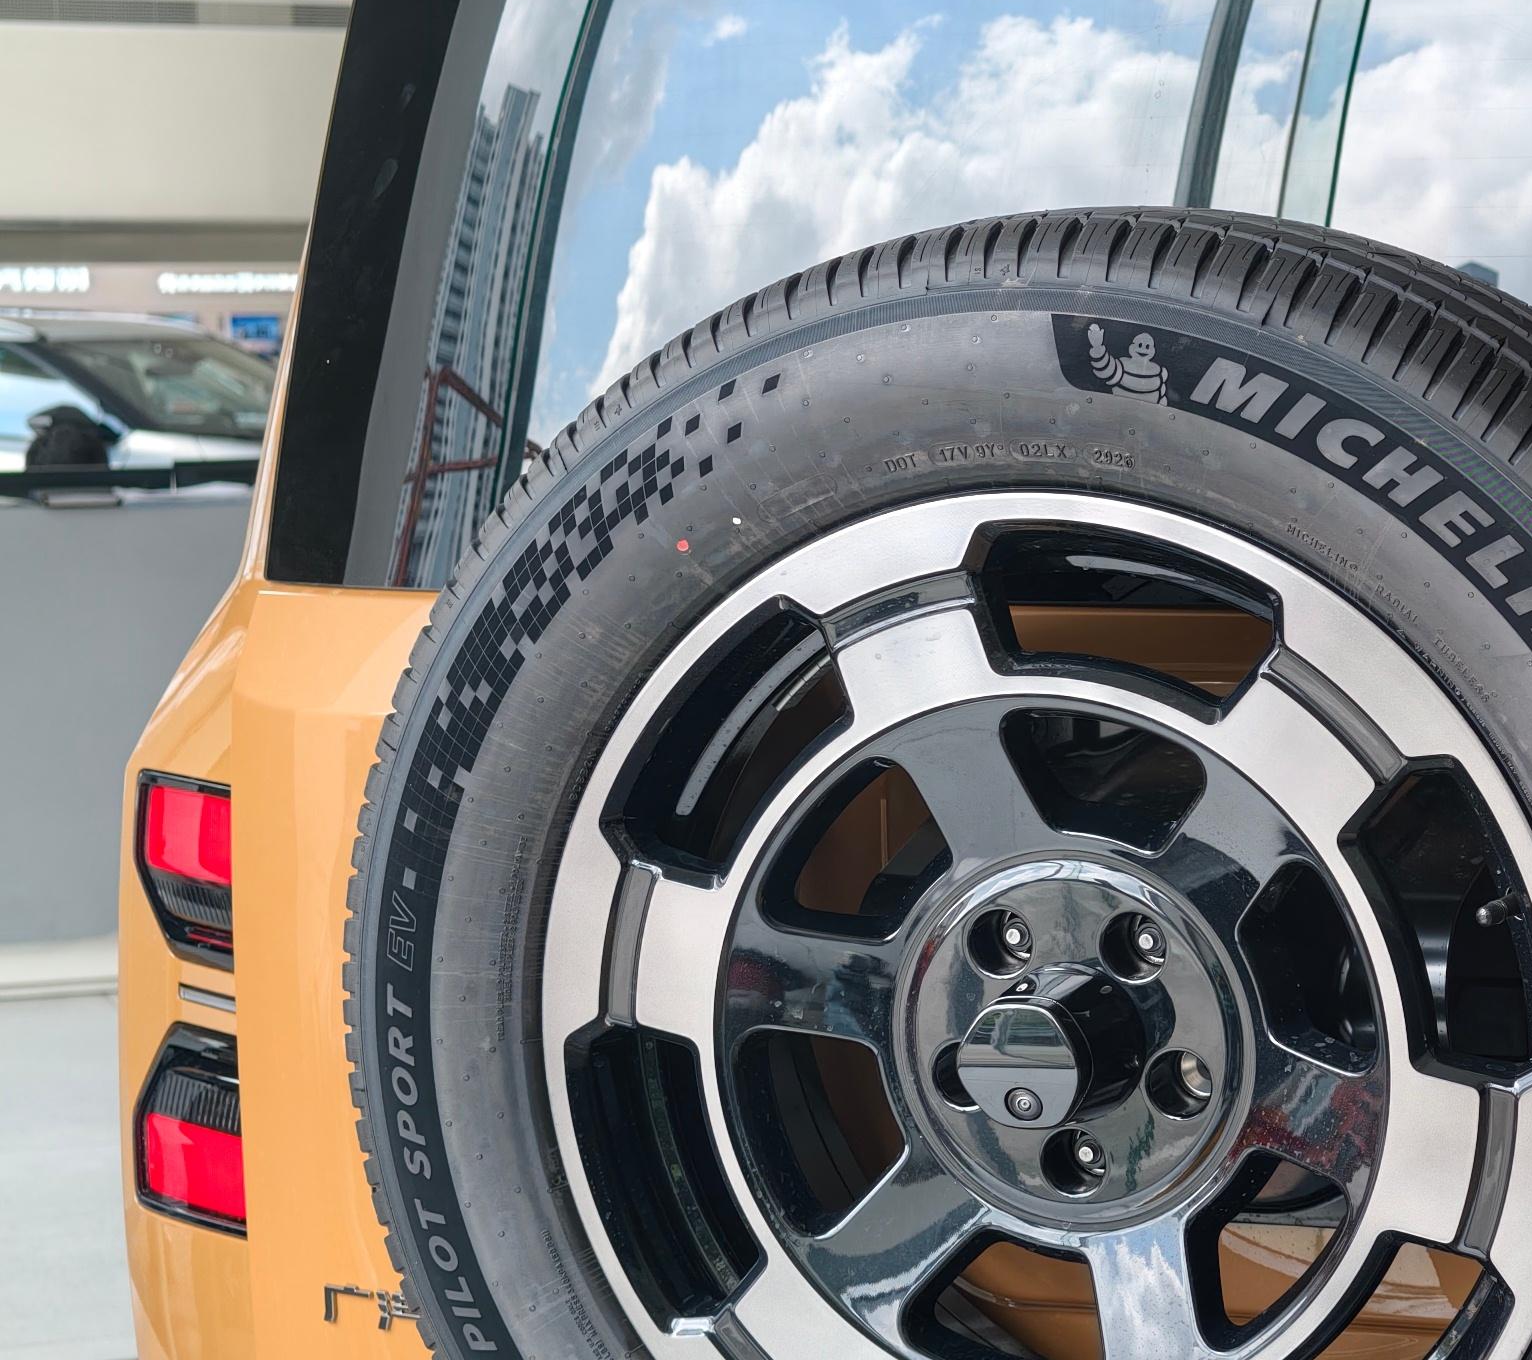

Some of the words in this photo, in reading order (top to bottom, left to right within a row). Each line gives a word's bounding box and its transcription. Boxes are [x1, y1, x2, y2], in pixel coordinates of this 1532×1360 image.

[883, 452, 916, 474] DOT
[938, 445, 968, 461] 17V
[387, 890, 419, 972] EV
[387, 982, 435, 1177] SPORT
[414, 1199, 499, 1353] PILOT
